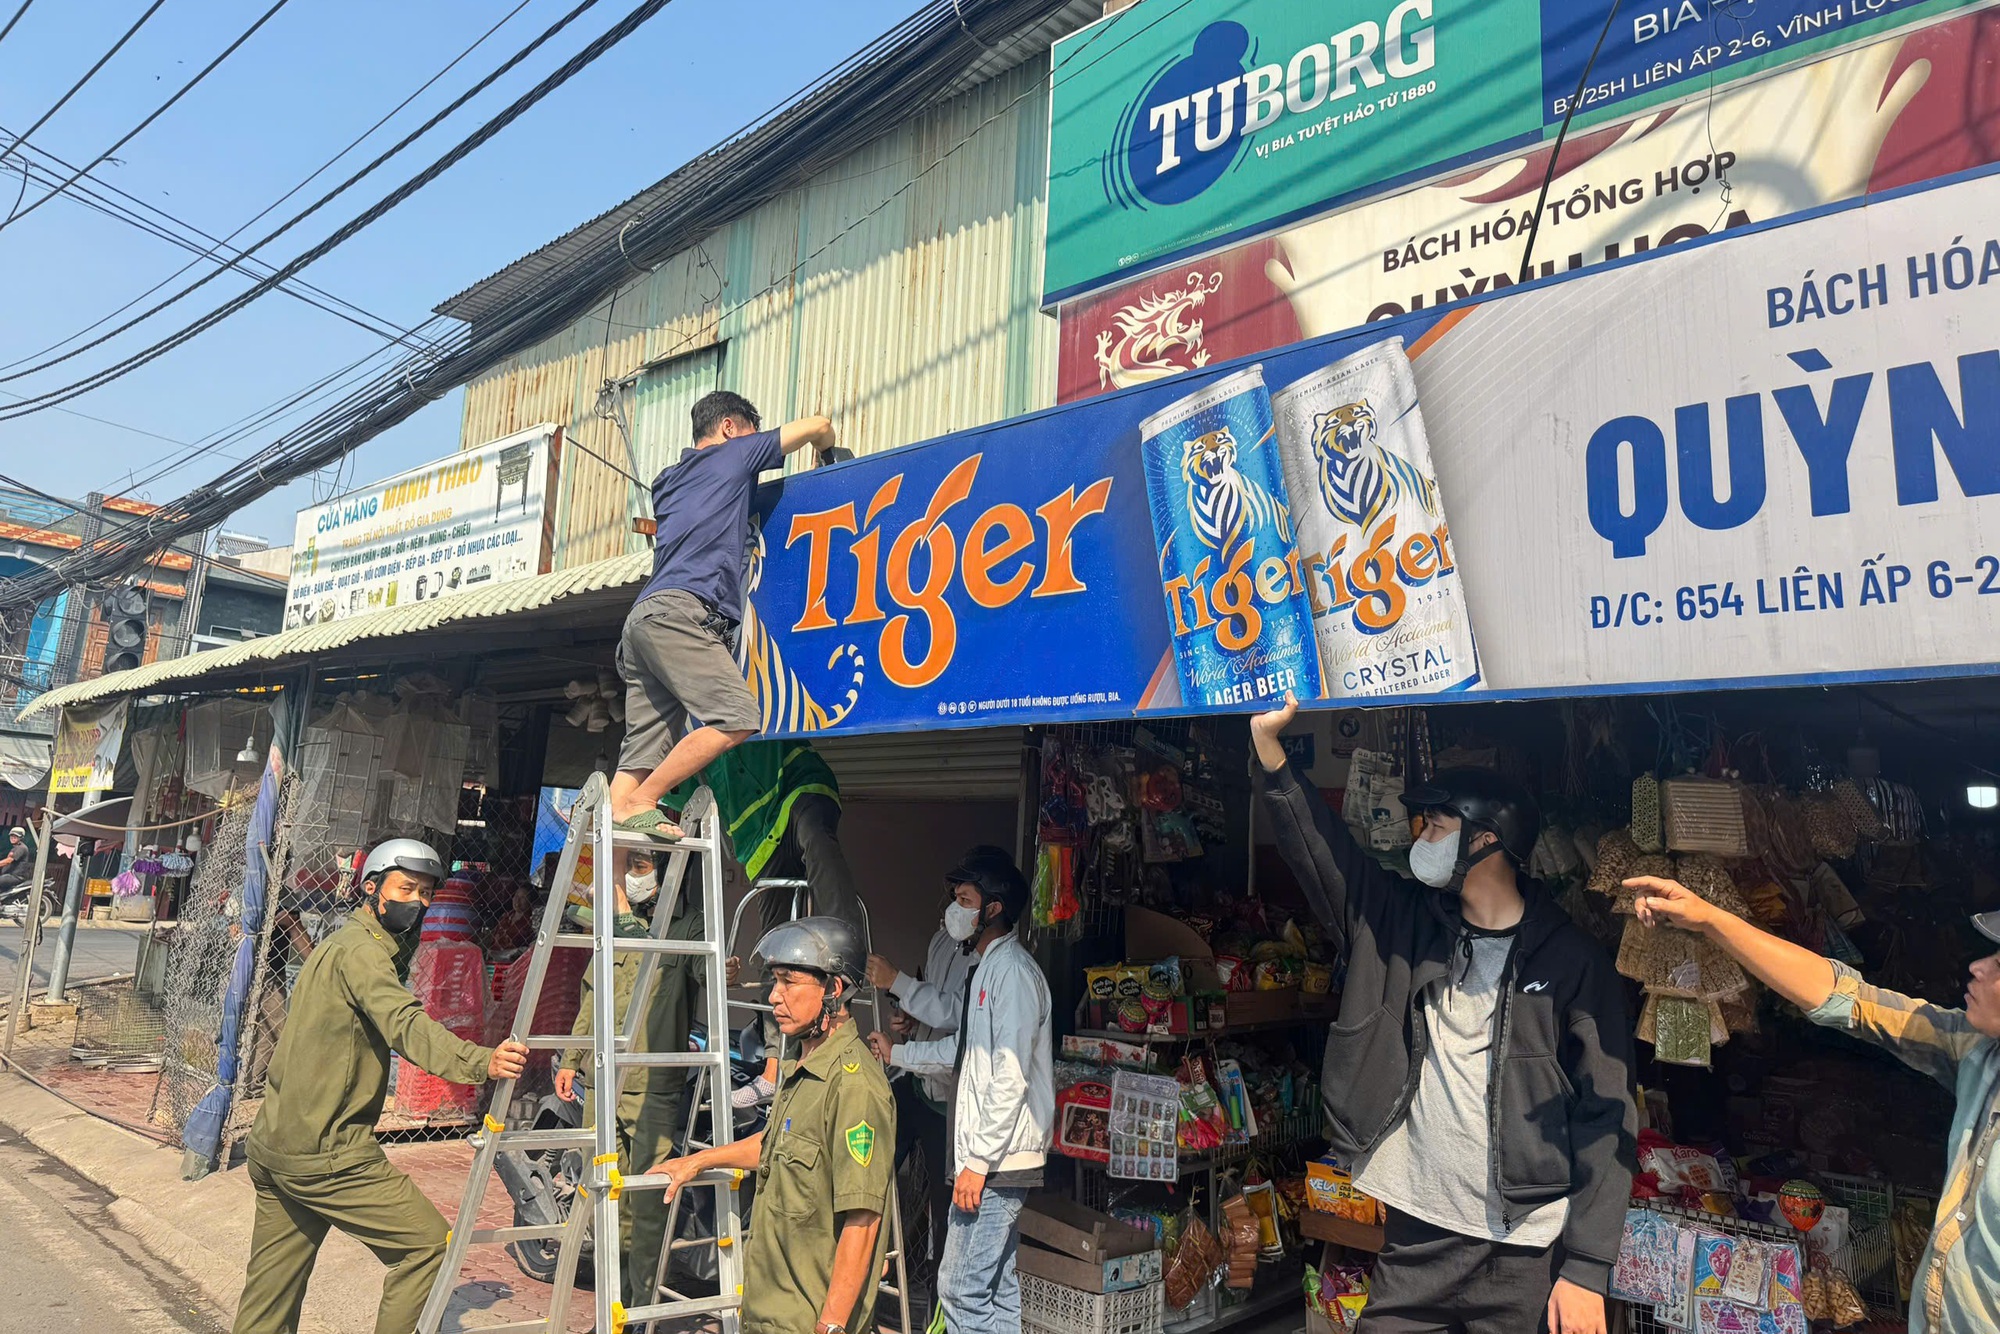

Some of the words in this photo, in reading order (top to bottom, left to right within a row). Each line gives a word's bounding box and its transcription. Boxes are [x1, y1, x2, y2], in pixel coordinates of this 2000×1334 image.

[1633, 0, 1702, 44] BIA
[1633, 58, 1682, 89] LIÊN
[1689, 45, 1722, 71] ẤP
[1776, 9, 1843, 40] VĨNH
[1149, 0, 1435, 175] TUBORG
[1255, 143, 1269, 159] VỊ
[1272, 134, 1295, 152] BIA
[1297, 115, 1341, 137] TUYỆT
[1343, 102, 1375, 125] HẢO
[1378, 91, 1399, 111] TỪ
[1401, 80, 1437, 103] 1880
[1383, 230, 1460, 273] BÁCH
[1471, 209, 1538, 249] HÓA
[1547, 178, 1644, 225] TỔNG
[1655, 151, 1736, 197] HỢP
[1767, 264, 1889, 328] BÁCH
[1906, 235, 2000, 299] HÓA
[1326, 369, 1352, 384] ASIAN
[1193, 397, 1216, 411] ASIAN
[382, 471, 432, 511] MẠNH
[317, 506, 340, 534] CỬA
[343, 497, 378, 526] HÀNG
[342, 535, 362, 549] TRANG
[417, 513, 429, 527] GIA
[431, 507, 453, 523] DỤNG
[418, 555, 426, 567] GA
[486, 532, 501, 550] CÁC
[785, 452, 1114, 688] Tiger
[1163, 536, 1304, 650] Tiger
[1302, 513, 1455, 635] Tiger
[1590, 592, 1664, 629] Đ/C:
[1675, 581, 1745, 622] 654
[1756, 565, 1844, 614] LIÊN
[1858, 552, 1912, 607] ẤP
[1417, 588, 1451, 605] 1932
[1271, 612, 1300, 629] 1932
[1316, 622, 1346, 638] SINCE
[1325, 635, 1379, 666] World
[1376, 610, 1457, 652] Acclaimed
[1179, 644, 1207, 660] SINCE
[1186, 657, 1235, 688] World
[1233, 634, 1306, 675] Acclaimed
[1343, 644, 1451, 691] CRYSTAL
[1011, 698, 1017, 708] 18
[1031, 695, 1052, 707] KHÔNG
[1256, 668, 1297, 698] BEER
[1374, 678, 1419, 696] FILTERED
[1422, 669, 1451, 684] LAGER
[1671, 1147, 1699, 1160] Karo
